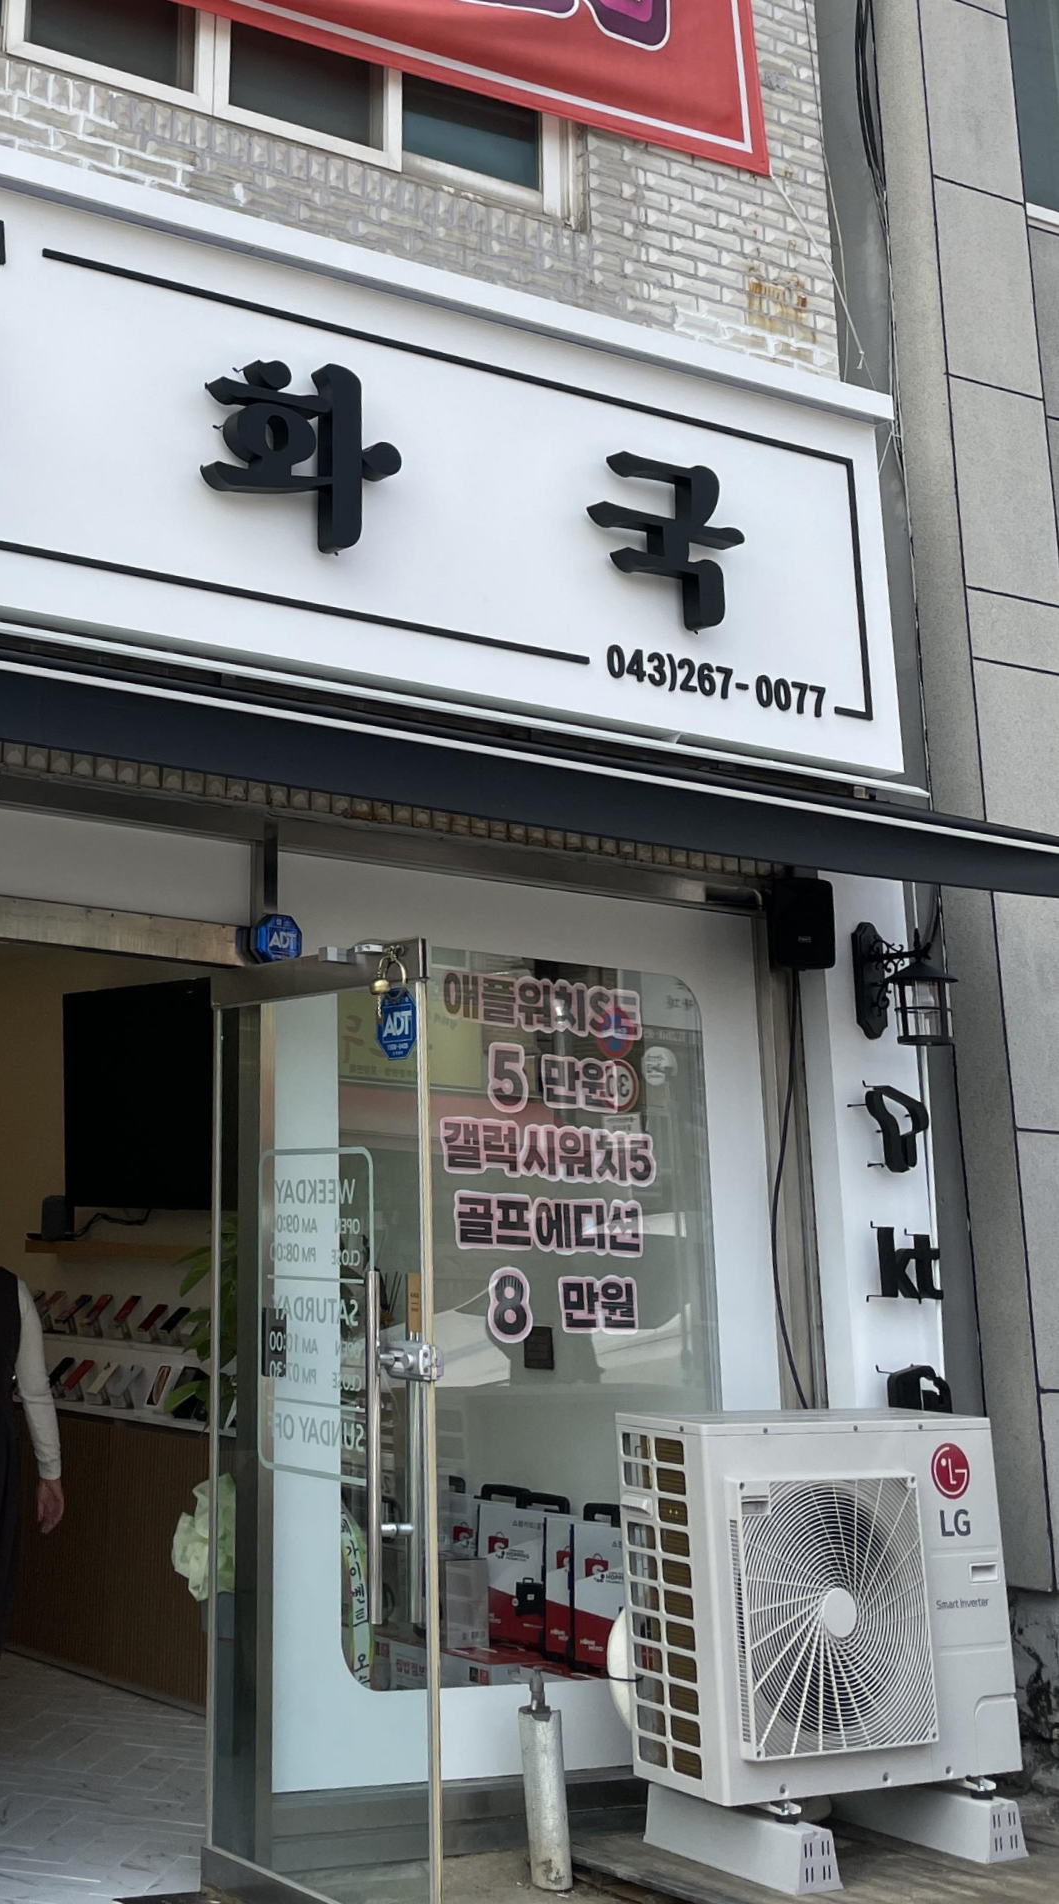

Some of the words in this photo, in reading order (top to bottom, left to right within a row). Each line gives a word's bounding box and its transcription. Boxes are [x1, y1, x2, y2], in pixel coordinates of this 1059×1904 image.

[269, 930, 297, 950] ADT
[382, 1010, 412, 1037] ADT
[443, 971, 639, 1037] 애플워치SE
[490, 1046, 526, 1110] 5
[543, 1057, 616, 1111] 만원
[443, 1120, 654, 1184] 갤럭시워치5
[456, 1194, 642, 1254] 골프에디션
[875, 1224, 944, 1301] kt
[492, 1271, 529, 1338] 8
[561, 1279, 637, 1331] 만원
[939, 1508, 972, 1537] LG
[936, 1599, 959, 1610] Smart
[959, 1598, 989, 1609] Inverter
